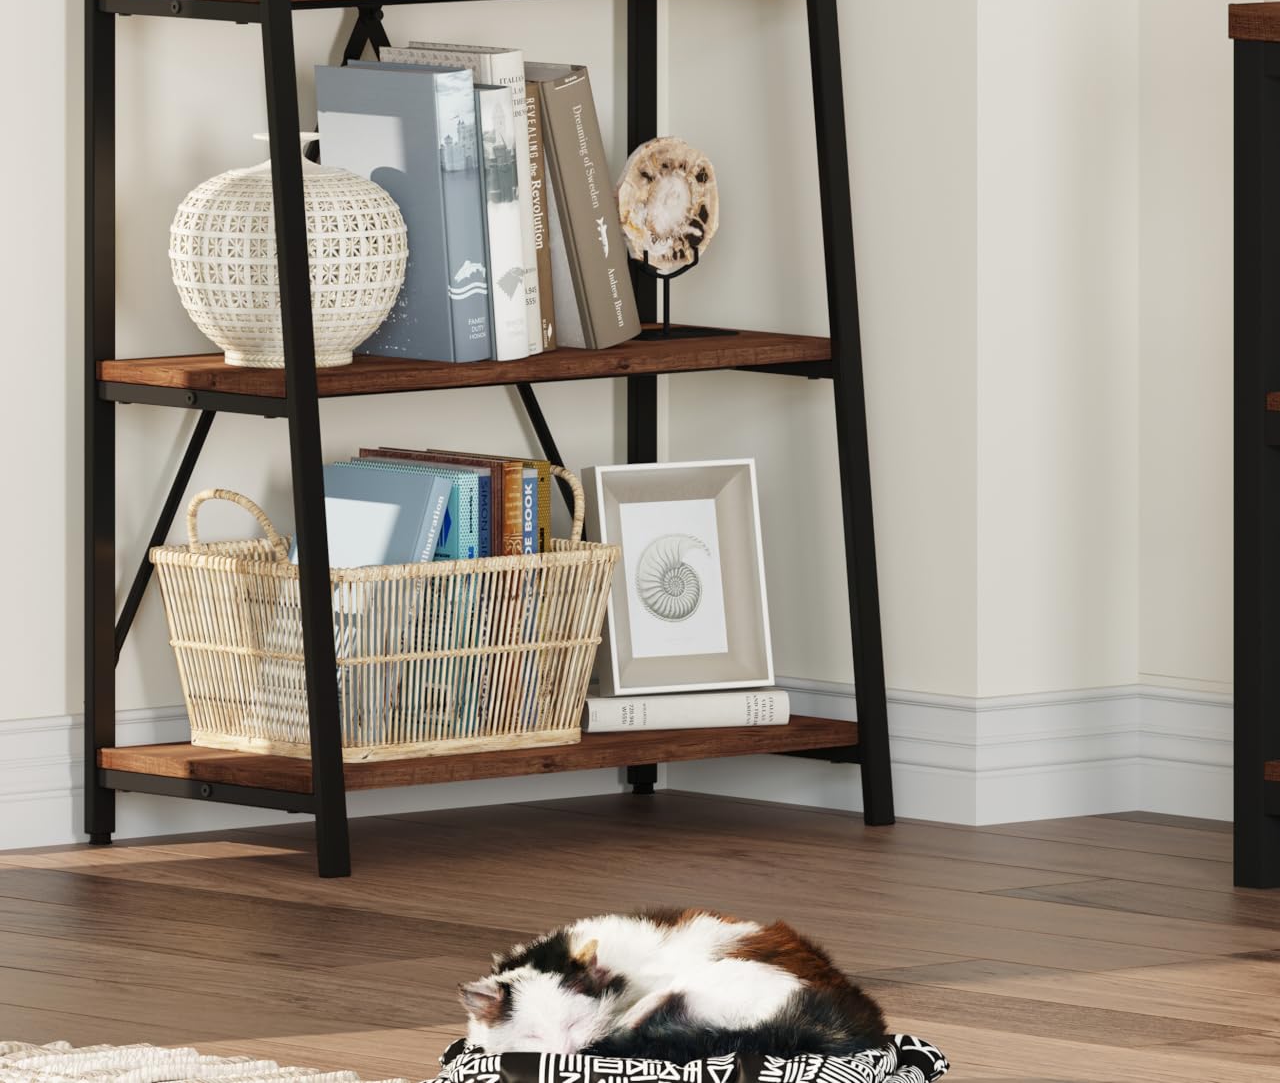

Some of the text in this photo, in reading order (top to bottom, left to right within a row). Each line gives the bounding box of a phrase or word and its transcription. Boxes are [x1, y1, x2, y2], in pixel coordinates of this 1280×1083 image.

[526, 97, 545, 250] REVEALING the Revolution
[572, 104, 601, 209] Dreaming of Sweden
[607, 267, 625, 327] Andrew Brown
[481, 480, 489, 531] SIMON
[525, 483, 533, 532] BOOK
